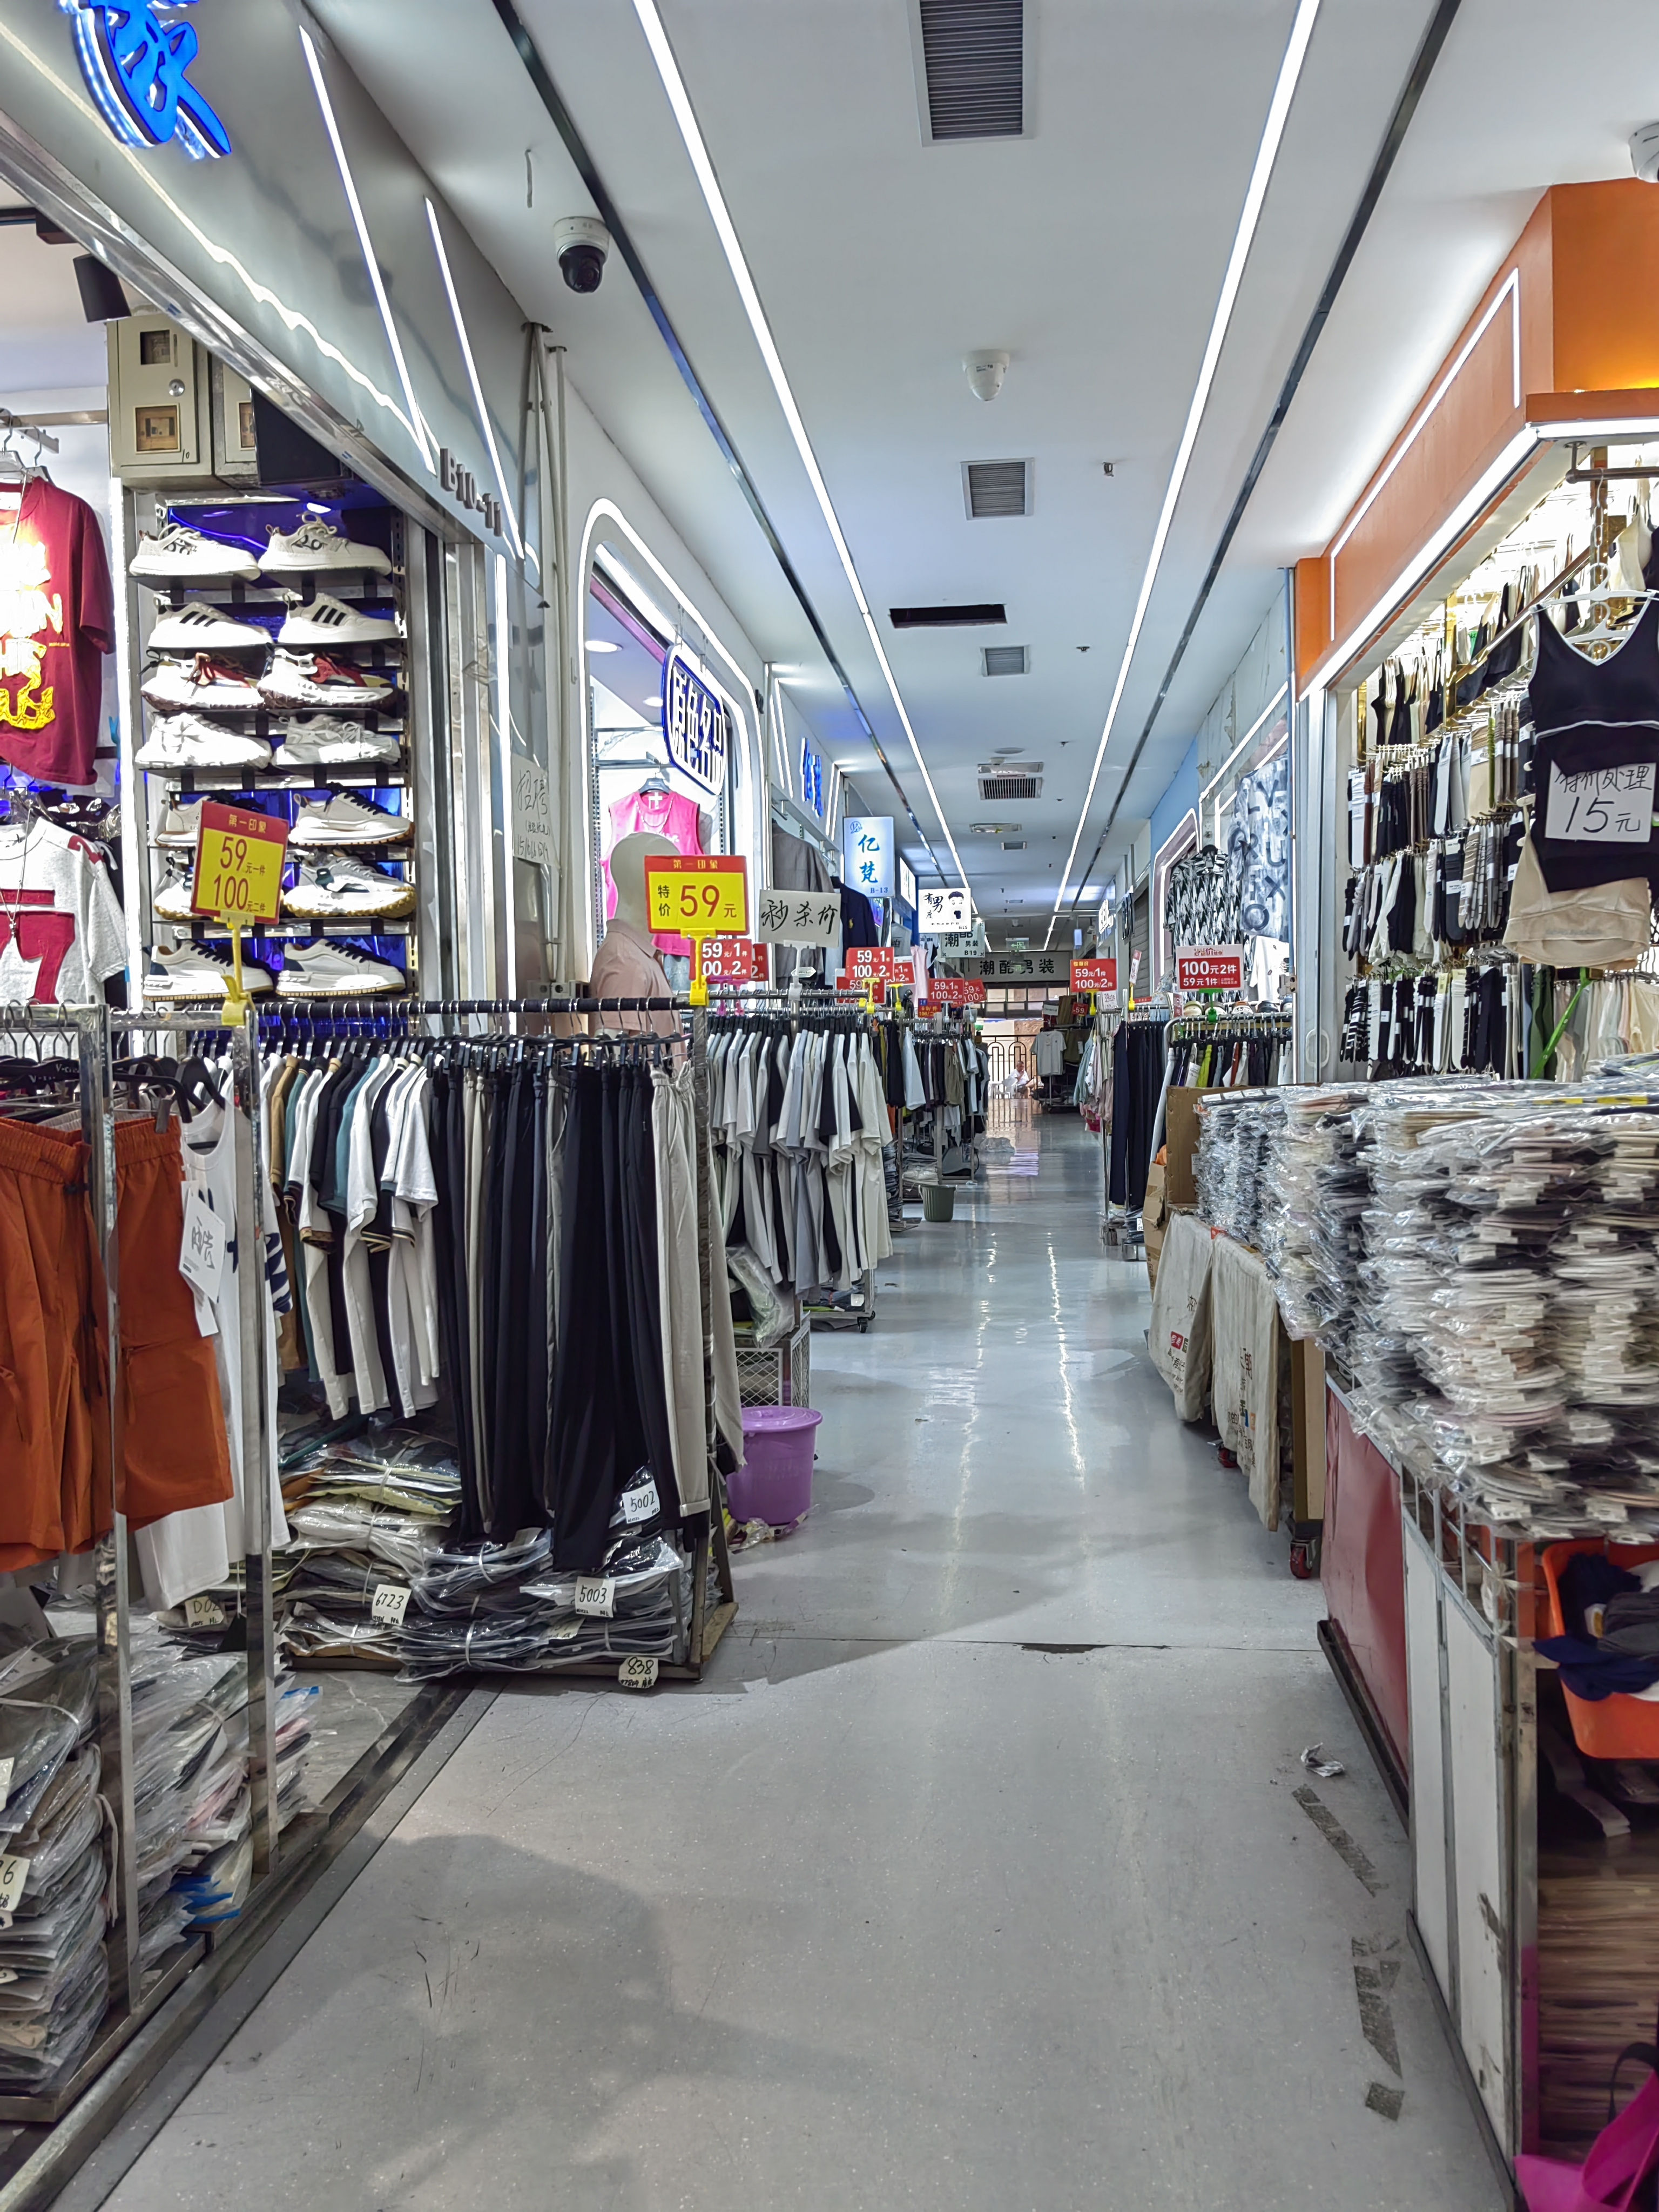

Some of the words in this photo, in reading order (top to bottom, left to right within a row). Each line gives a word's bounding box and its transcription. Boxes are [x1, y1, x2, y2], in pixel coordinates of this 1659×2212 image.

[228, 813, 267, 833] 第一印象
[1565, 796, 1641, 833] 15元
[673, 859, 718, 869] 第一印象
[858, 834, 880, 883] 亿梵
[657, 885, 671, 917] 特价
[679, 885, 737, 918] 59元
[760, 899, 838, 935] 秒杀价
[630, 1491, 656, 1513] 5002
[375, 1591, 404, 1610] 6723
[579, 1584, 607, 1604] 5003
[628, 1656, 654, 1675] 838
